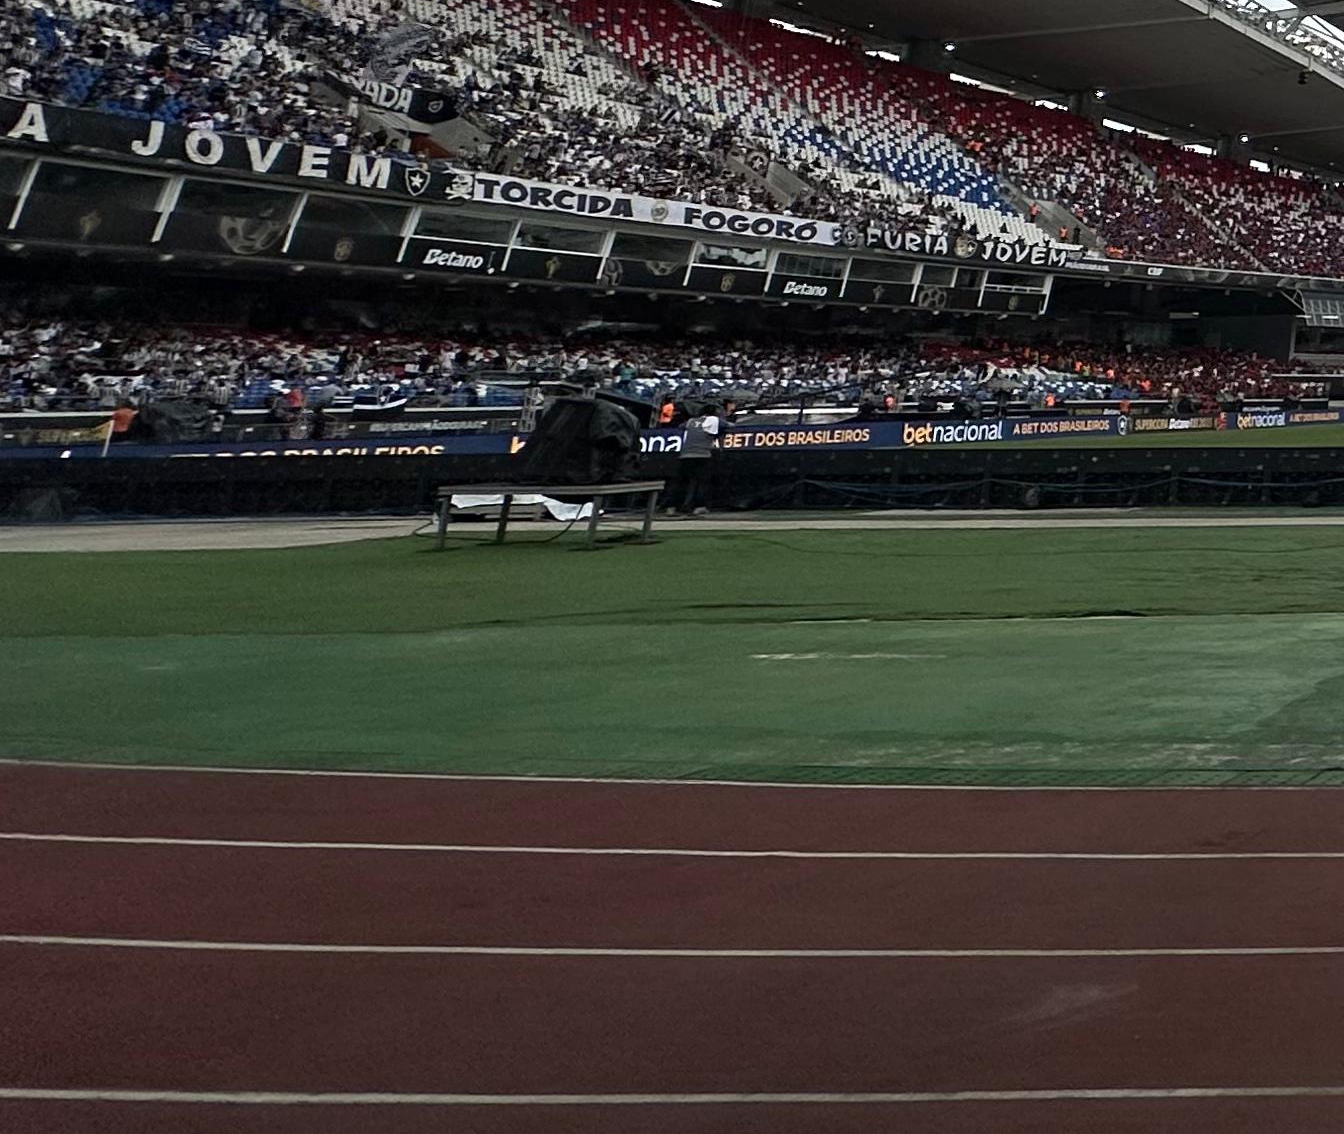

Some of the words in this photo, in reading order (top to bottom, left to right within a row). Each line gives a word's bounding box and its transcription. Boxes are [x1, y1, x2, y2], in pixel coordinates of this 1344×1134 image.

[7, 102, 50, 143] A
[131, 119, 392, 189] JOVEM
[477, 178, 634, 218] TORCIDA
[684, 207, 819, 241] FOGORÓ
[422, 249, 485, 269] Betano
[980, 241, 1068, 267] JOVEM
[783, 281, 829, 297] Betano
[723, 432, 754, 448] BET
[754, 431, 786, 447] DOS
[787, 428, 871, 446] BRASILEIROS
[903, 420, 1003, 447] betnacional
[1021, 422, 1039, 435] BET
[1040, 421, 1059, 434] DOS
[1059, 419, 1110, 432] BRASILEIROS
